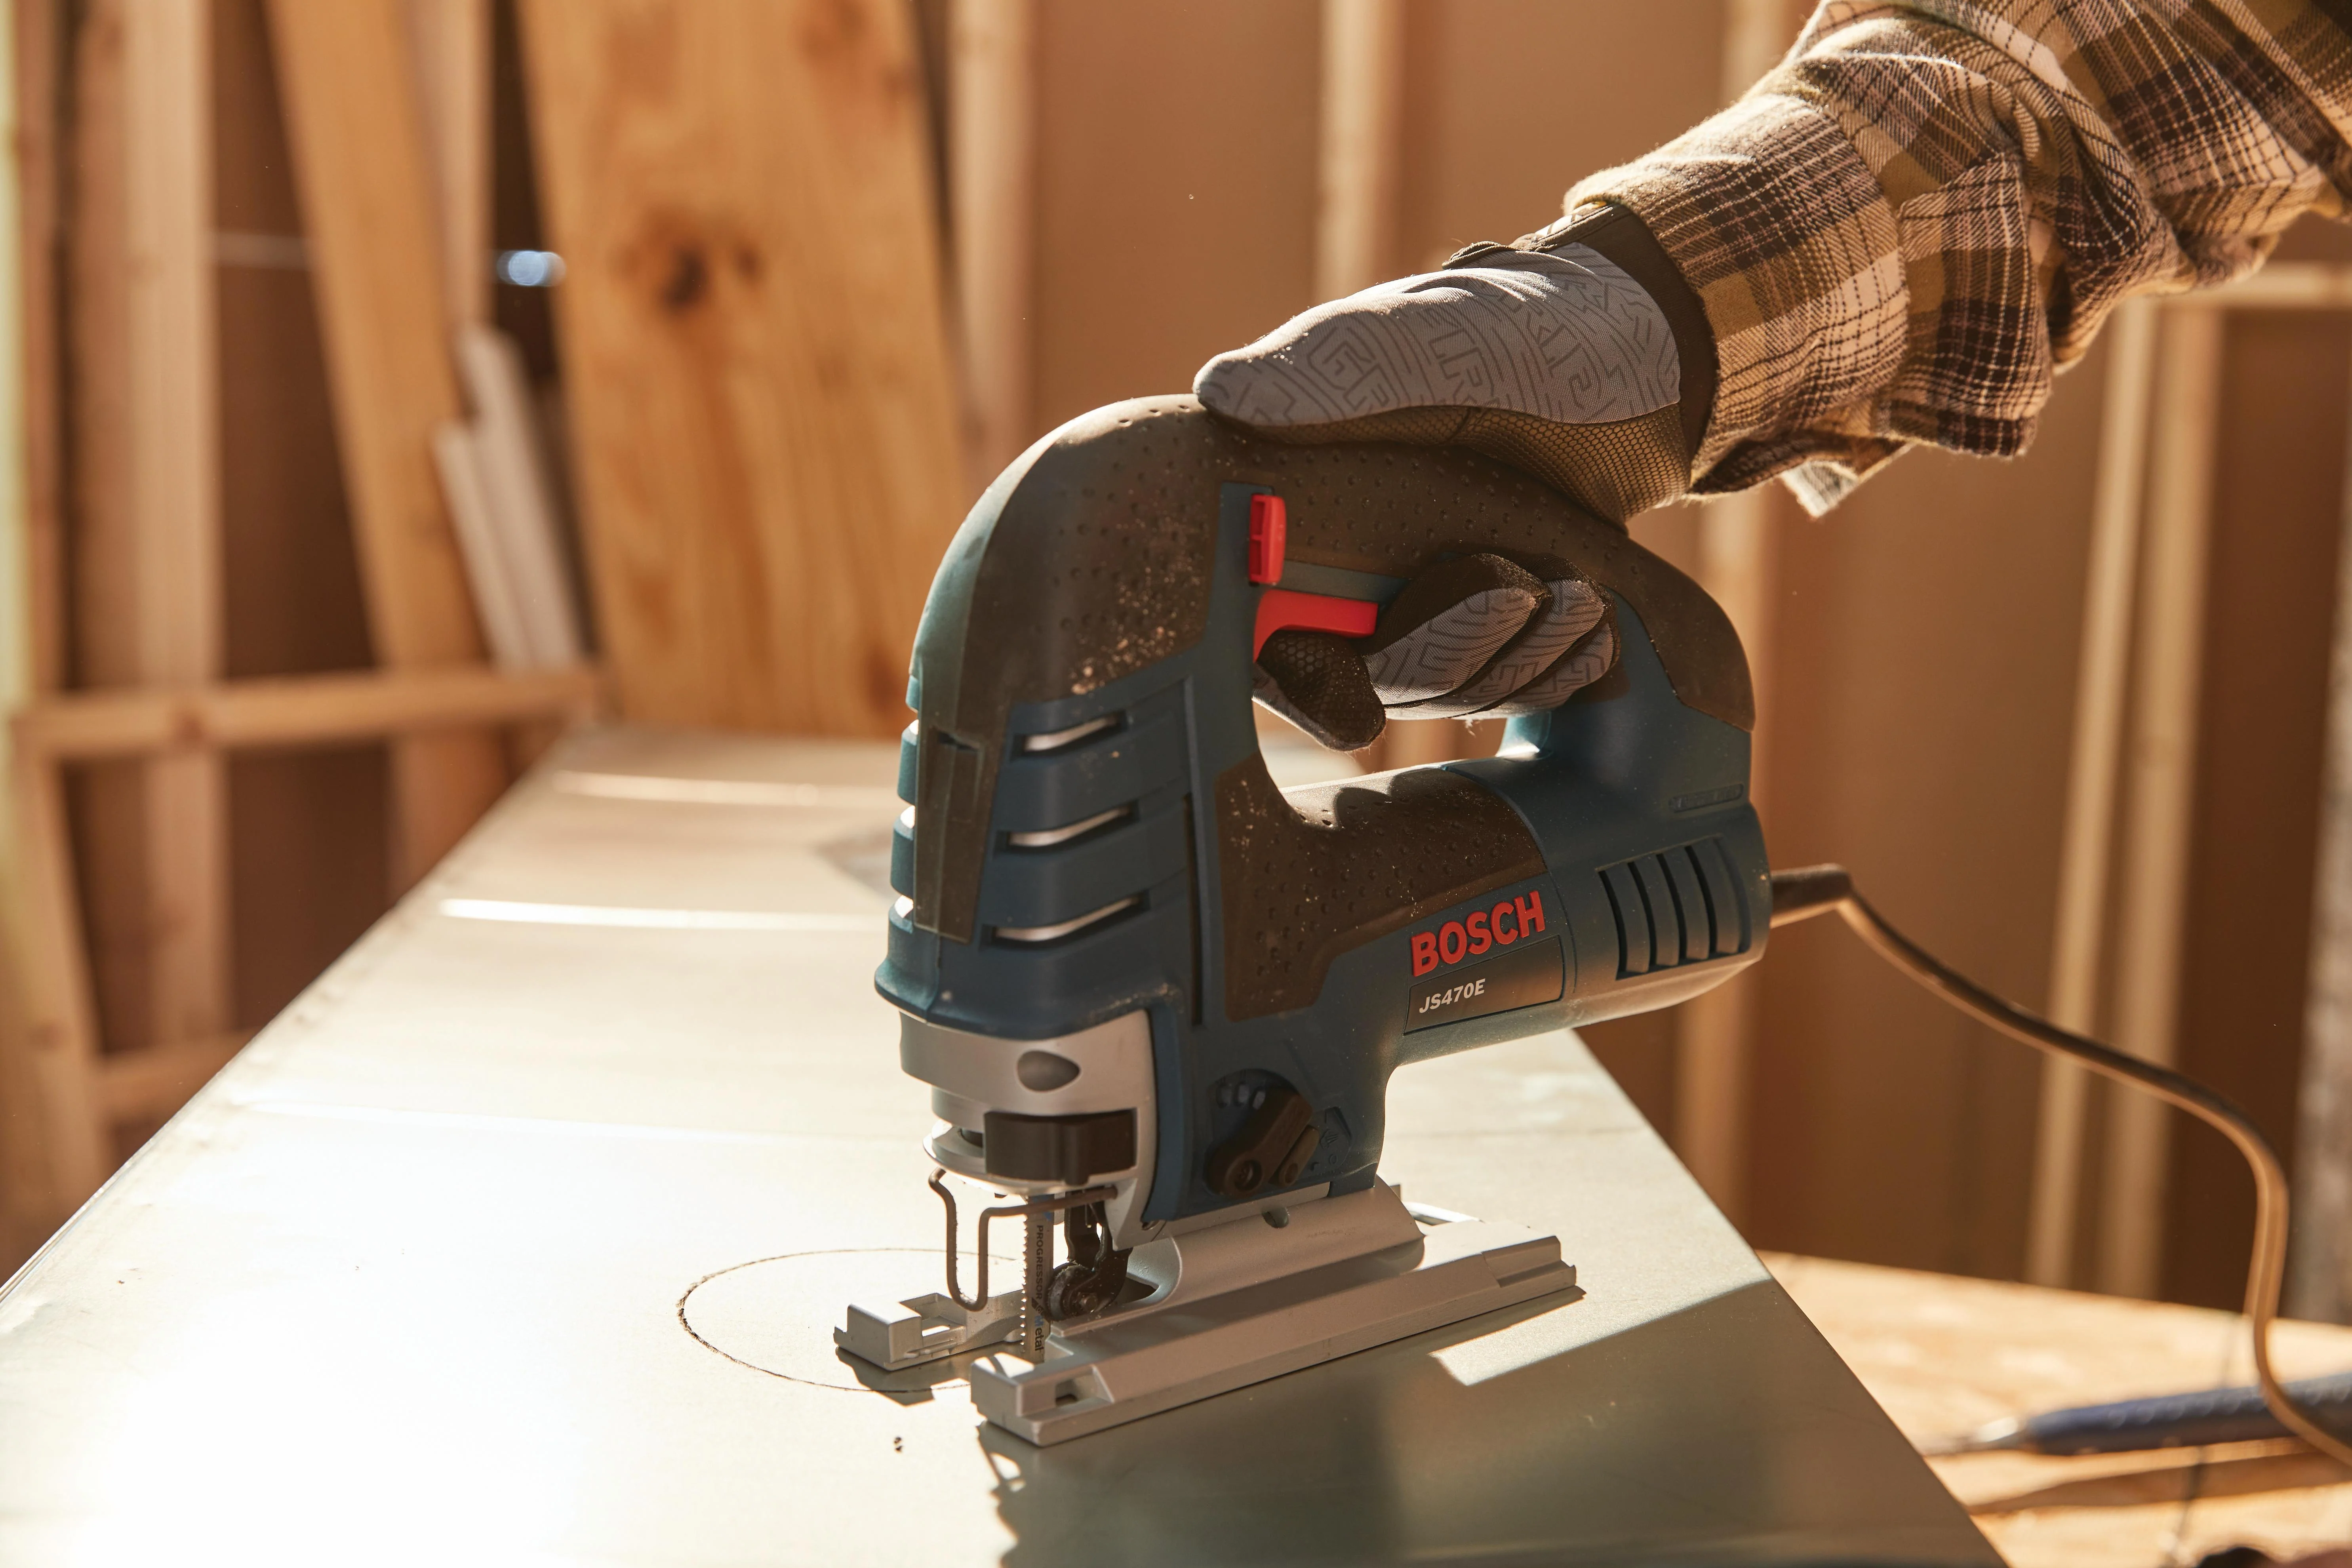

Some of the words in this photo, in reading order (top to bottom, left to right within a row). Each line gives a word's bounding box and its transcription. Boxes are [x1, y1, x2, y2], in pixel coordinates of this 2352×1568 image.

[1411, 890, 1545, 977] BOSCH
[1419, 978, 1485, 1014] JS470E
[1034, 1315, 1044, 1351] Metal
